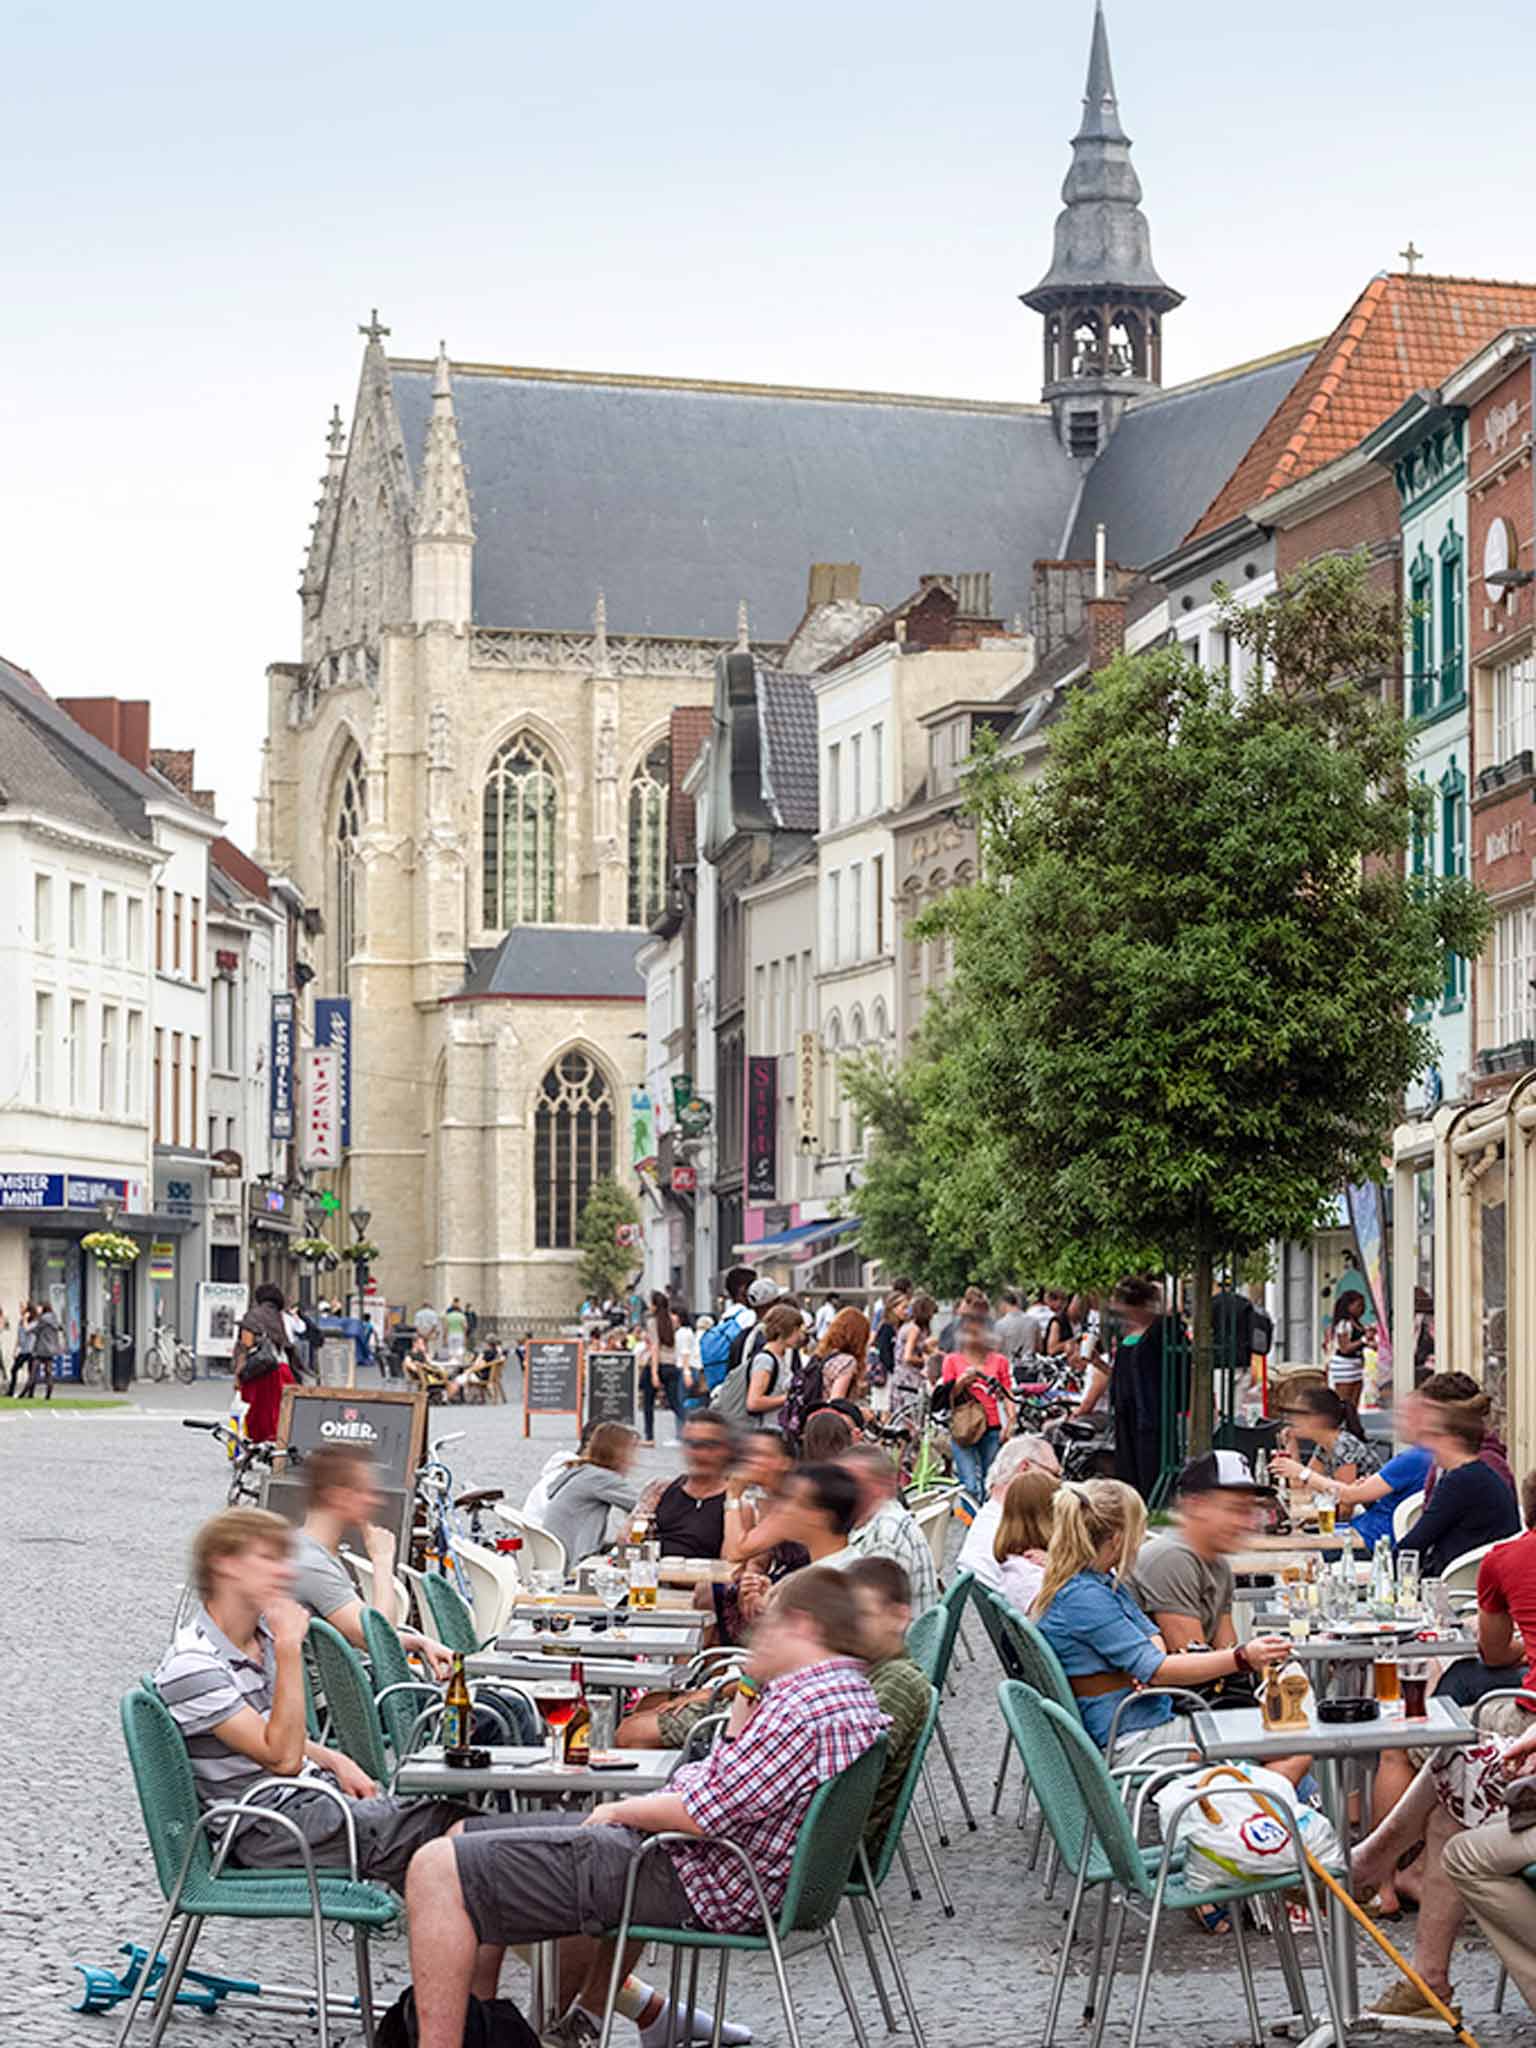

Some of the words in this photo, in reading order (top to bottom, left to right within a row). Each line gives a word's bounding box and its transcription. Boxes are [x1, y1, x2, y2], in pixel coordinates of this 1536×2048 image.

[276, 1021, 290, 1109] PROMILLE
[0, 1174, 49, 1190] MISTER
[2, 1190, 44, 1206] MINIT
